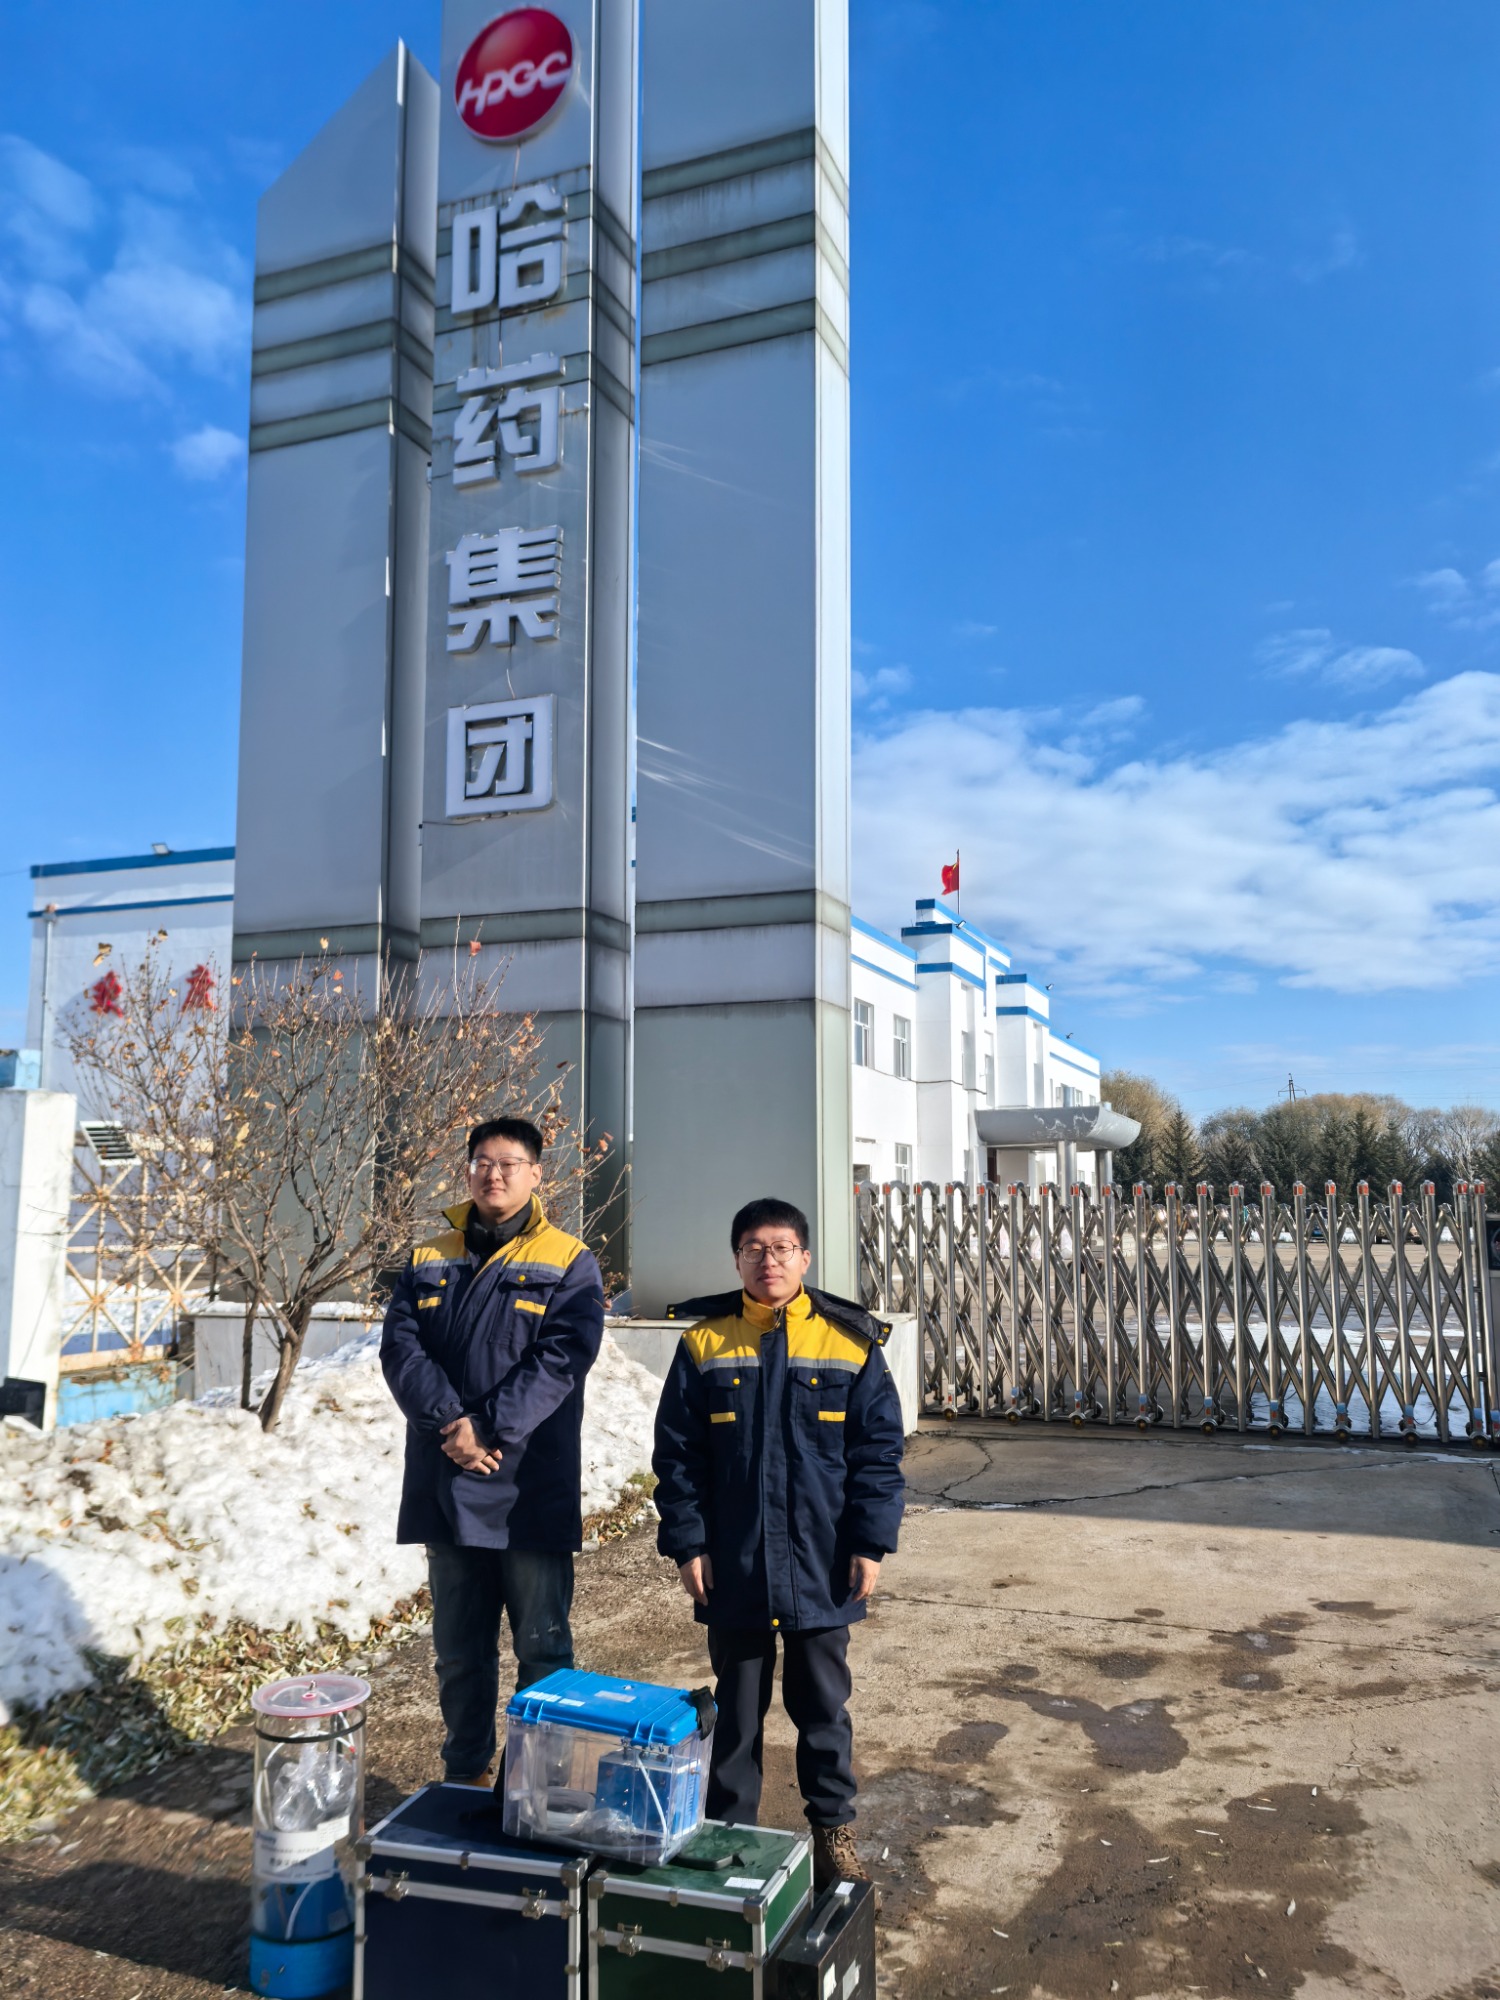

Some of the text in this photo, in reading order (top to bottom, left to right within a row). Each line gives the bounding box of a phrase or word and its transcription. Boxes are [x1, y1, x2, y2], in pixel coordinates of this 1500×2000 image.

[458, 50, 571, 116] HPGC
[446, 183, 565, 818] 哈药集团
